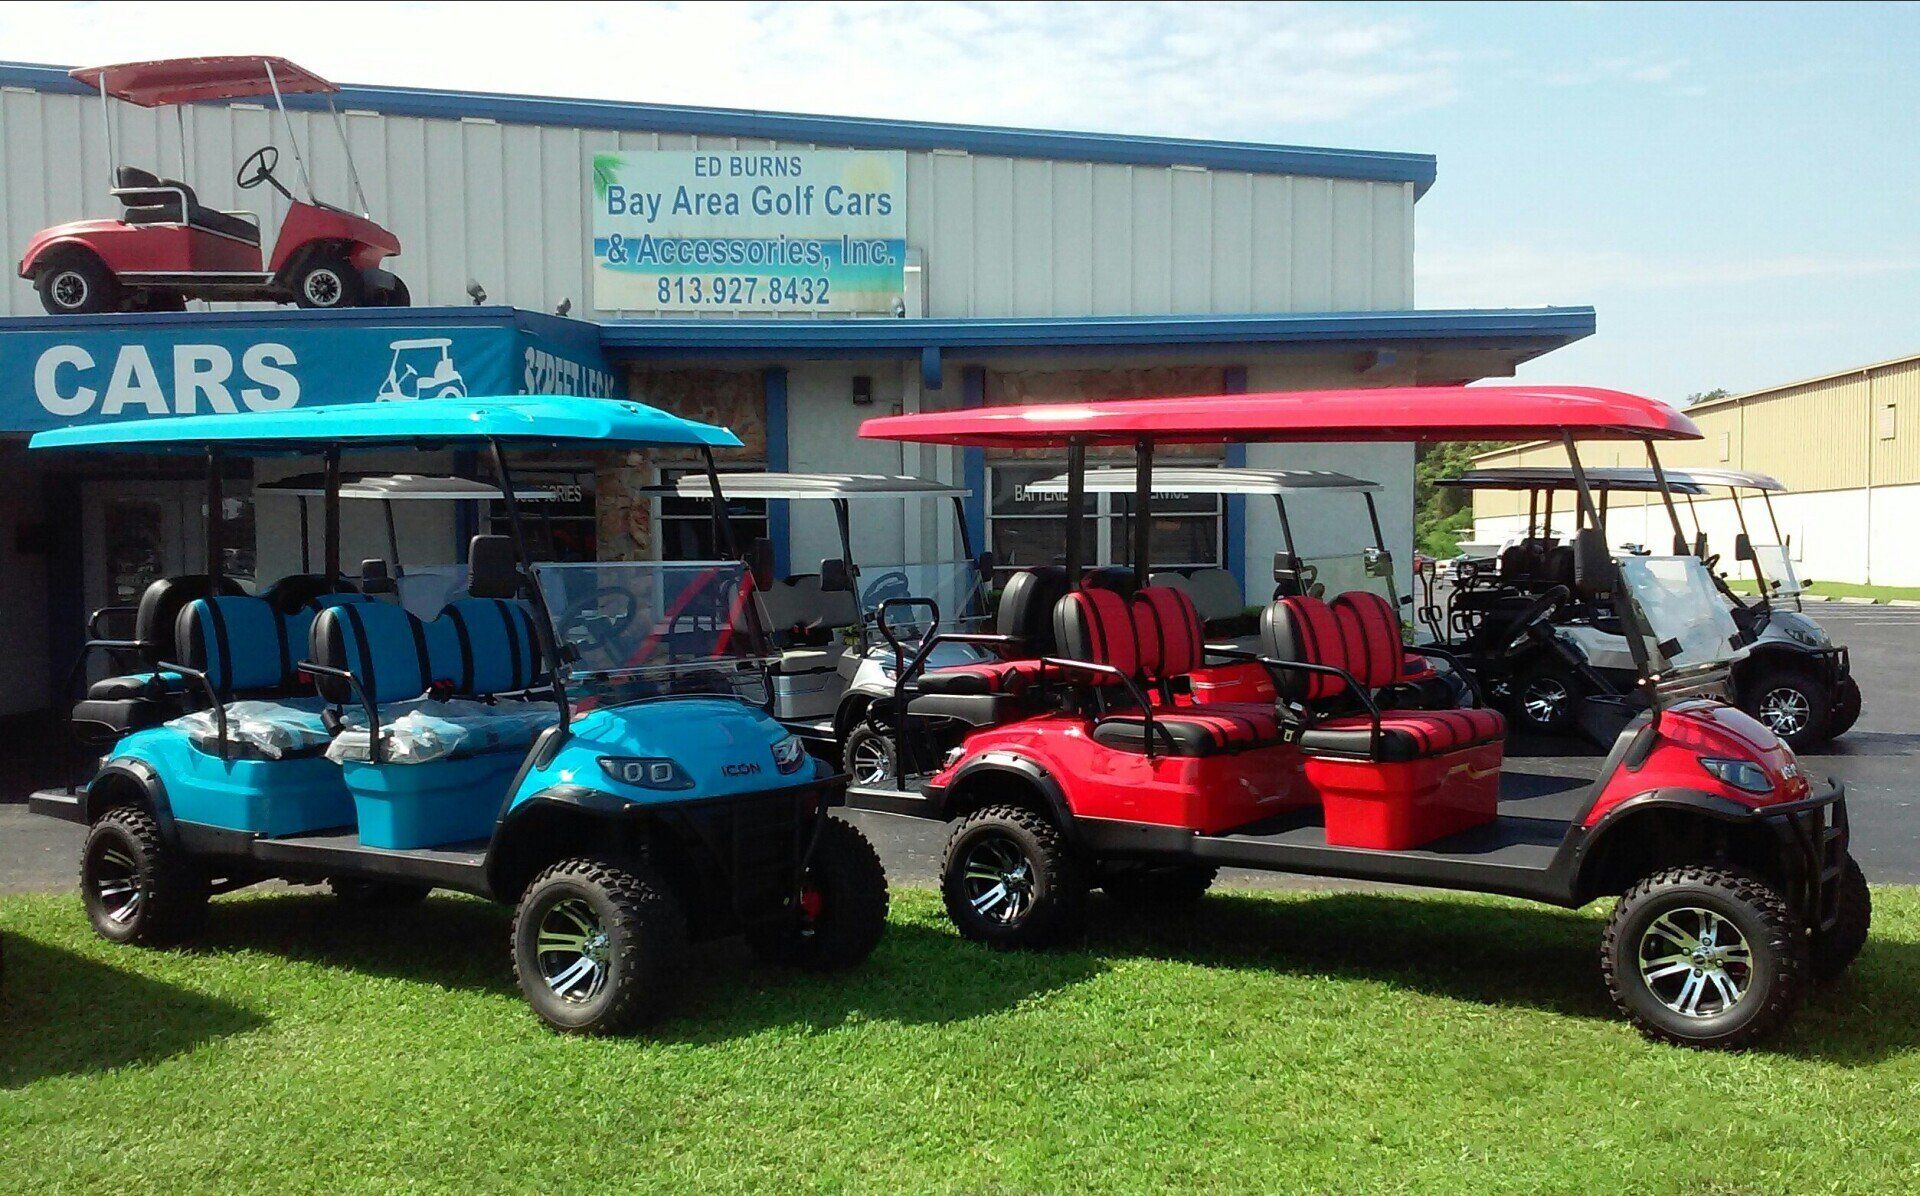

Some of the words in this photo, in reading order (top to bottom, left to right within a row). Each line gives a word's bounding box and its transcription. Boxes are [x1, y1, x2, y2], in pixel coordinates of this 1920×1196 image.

[695, 156, 722, 177] ED
[730, 156, 802, 177] BURNS
[607, 185, 662, 223] Bay
[671, 186, 740, 216] Area
[751, 184, 814, 216] Golf
[824, 184, 892, 216] Cars
[607, 233, 628, 265] &
[637, 233, 830, 271] Accessories,
[841, 235, 895, 265] Inc.
[657, 276, 830, 305] 813.927.8432
[34, 342, 300, 417] CARS
[1014, 484, 1069, 502] BATTERIE
